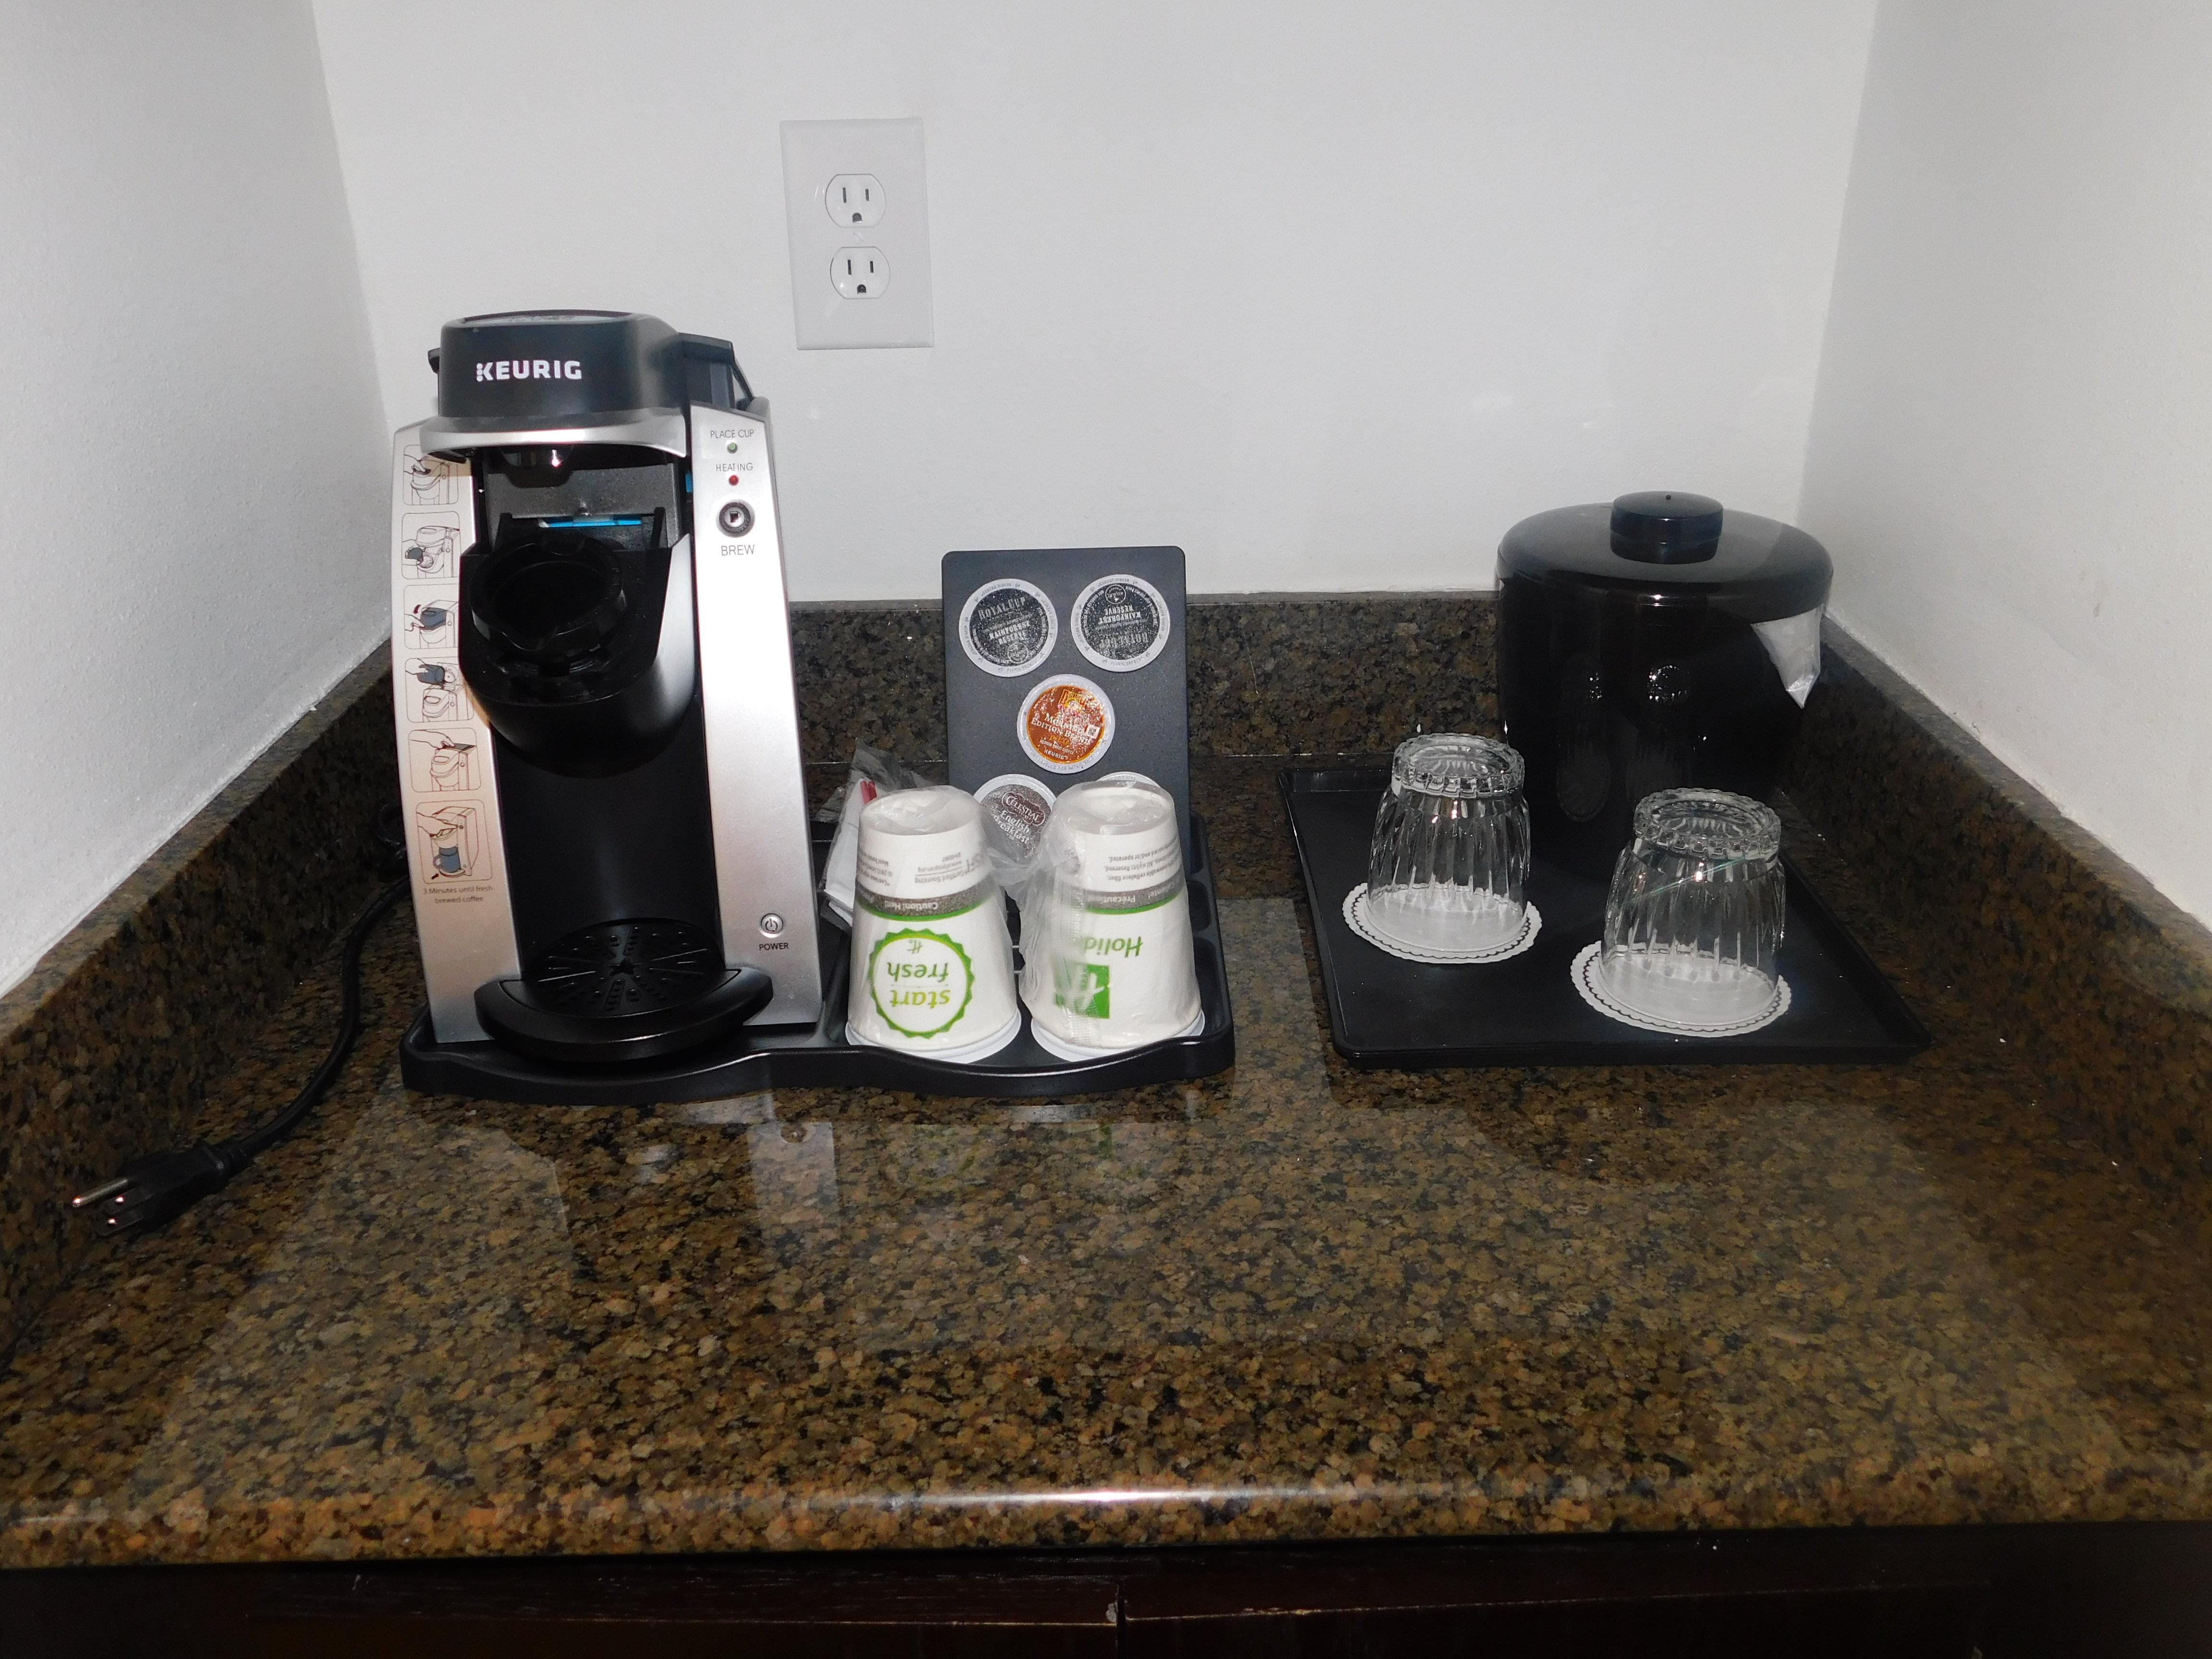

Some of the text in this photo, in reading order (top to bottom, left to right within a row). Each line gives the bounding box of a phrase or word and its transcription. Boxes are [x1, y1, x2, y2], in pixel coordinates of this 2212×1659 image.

[477, 360, 582, 382] KEURIG
[710, 429, 755, 439] PLACE CUP
[716, 462, 753, 471] HEATING
[721, 544, 755, 556] BREW
[978, 602, 1008, 620] ROYAL
[1104, 604, 1134, 615] RESERVE
[1098, 611, 1142, 625] RAINFOREST
[989, 620, 1030, 640] RAINFOREST
[998, 630, 1027, 645] RESERVE
[1045, 712, 1085, 735] MORNING
[1031, 718, 1092, 745] EDITION BLEND
[1044, 748, 1065, 760] KEURIG
[1006, 796, 1041, 821] CELESTIAL
[1001, 809, 1031, 834] English
[915, 876, 941, 884] Sourcing
[903, 902, 938, 911] Caution!
[759, 942, 789, 950] POWER
[887, 962, 949, 982] fresh
[890, 989, 951, 1010] start
